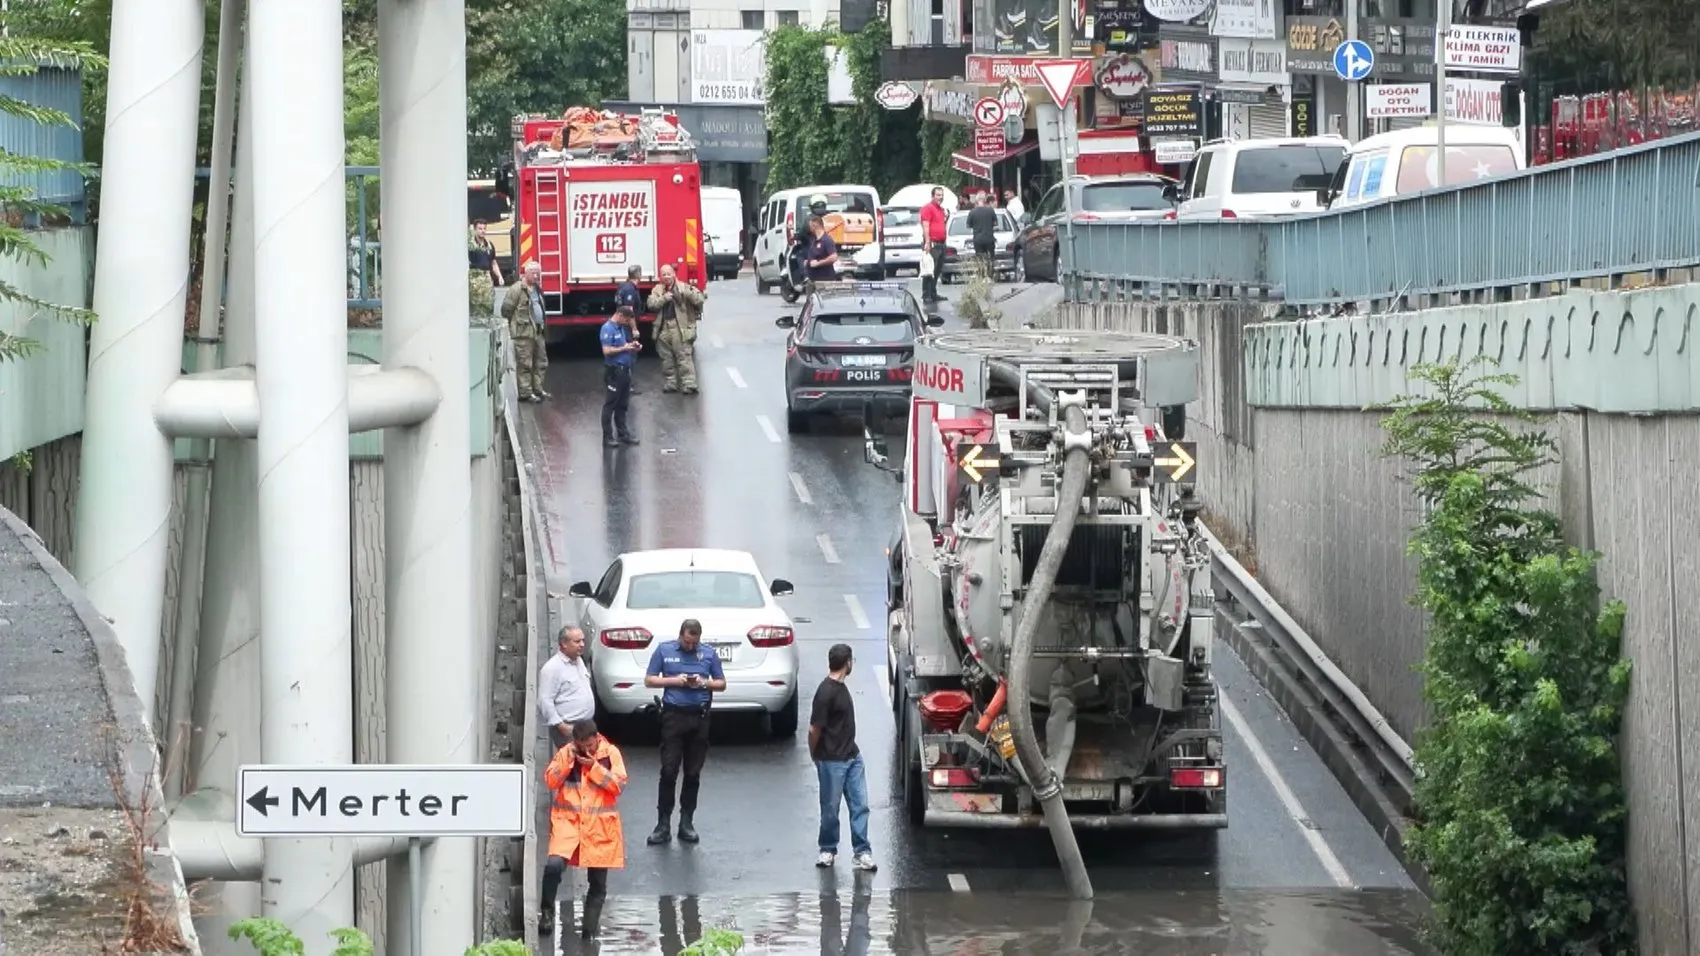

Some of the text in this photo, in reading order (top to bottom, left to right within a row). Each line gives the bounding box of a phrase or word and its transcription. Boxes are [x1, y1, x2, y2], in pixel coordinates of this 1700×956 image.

[1466, 30, 1516, 42] ELEKTRİK
[1446, 41, 1510, 53] KLİMA GAZI
[1451, 54, 1463, 62] VE
[699, 84, 720, 98] 0212
[721, 85, 736, 99] 655
[601, 236, 623, 251] 112
[847, 369, 881, 381] POLİS
[292, 787, 469, 817] Merter
